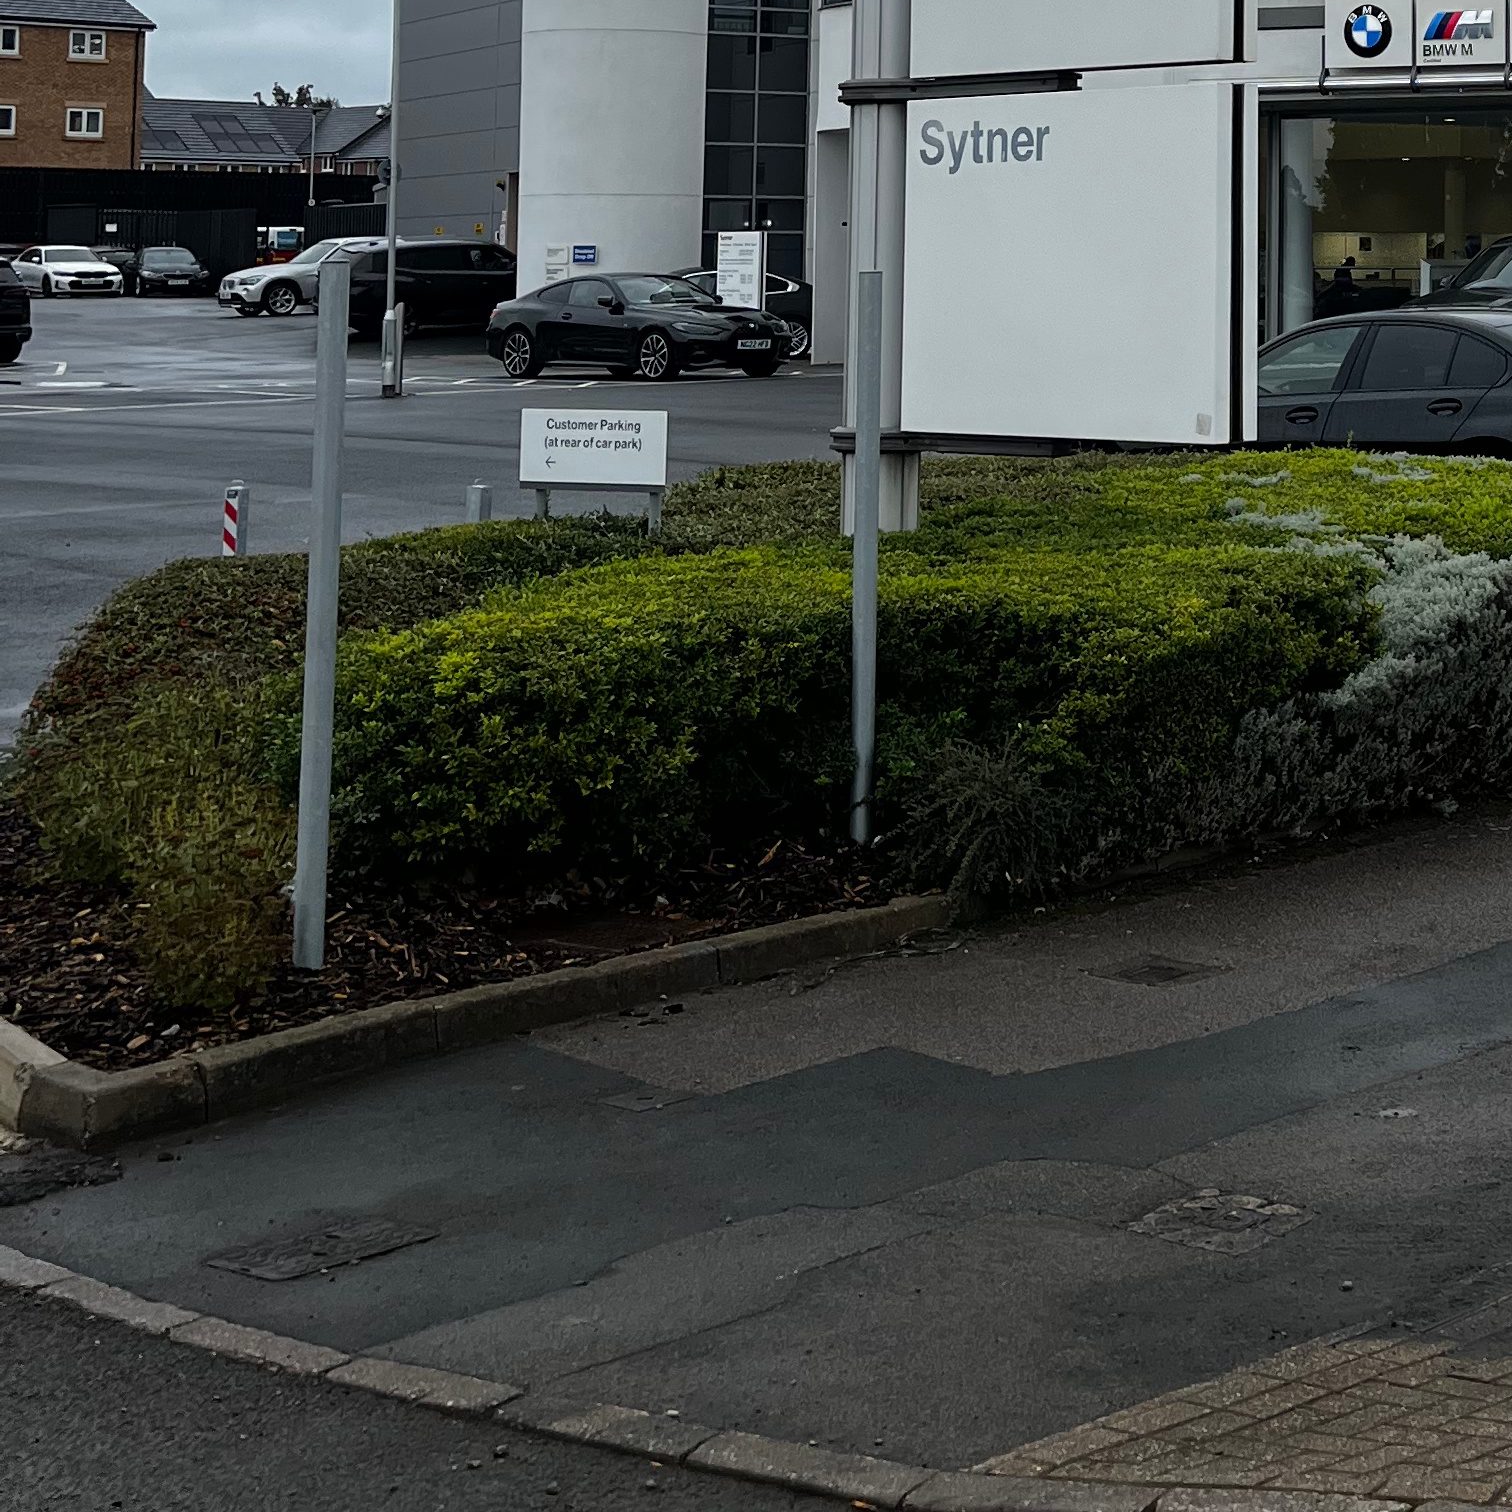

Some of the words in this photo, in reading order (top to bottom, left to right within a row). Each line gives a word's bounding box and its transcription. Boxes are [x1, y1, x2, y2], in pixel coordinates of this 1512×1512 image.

[1348, 5, 1388, 24] BMW
[1422, 42, 1458, 57] BMW
[1460, 42, 1474, 56] M
[919, 119, 1050, 175] Sytner
[546, 418, 598, 430] Customer
[600, 419, 641, 434] Parking
[544, 436, 558, 449] (at
[560, 438, 581, 448] rear
[583, 437, 594, 448] of
[595, 439, 612, 449] car
[614, 438, 642, 451] park)
